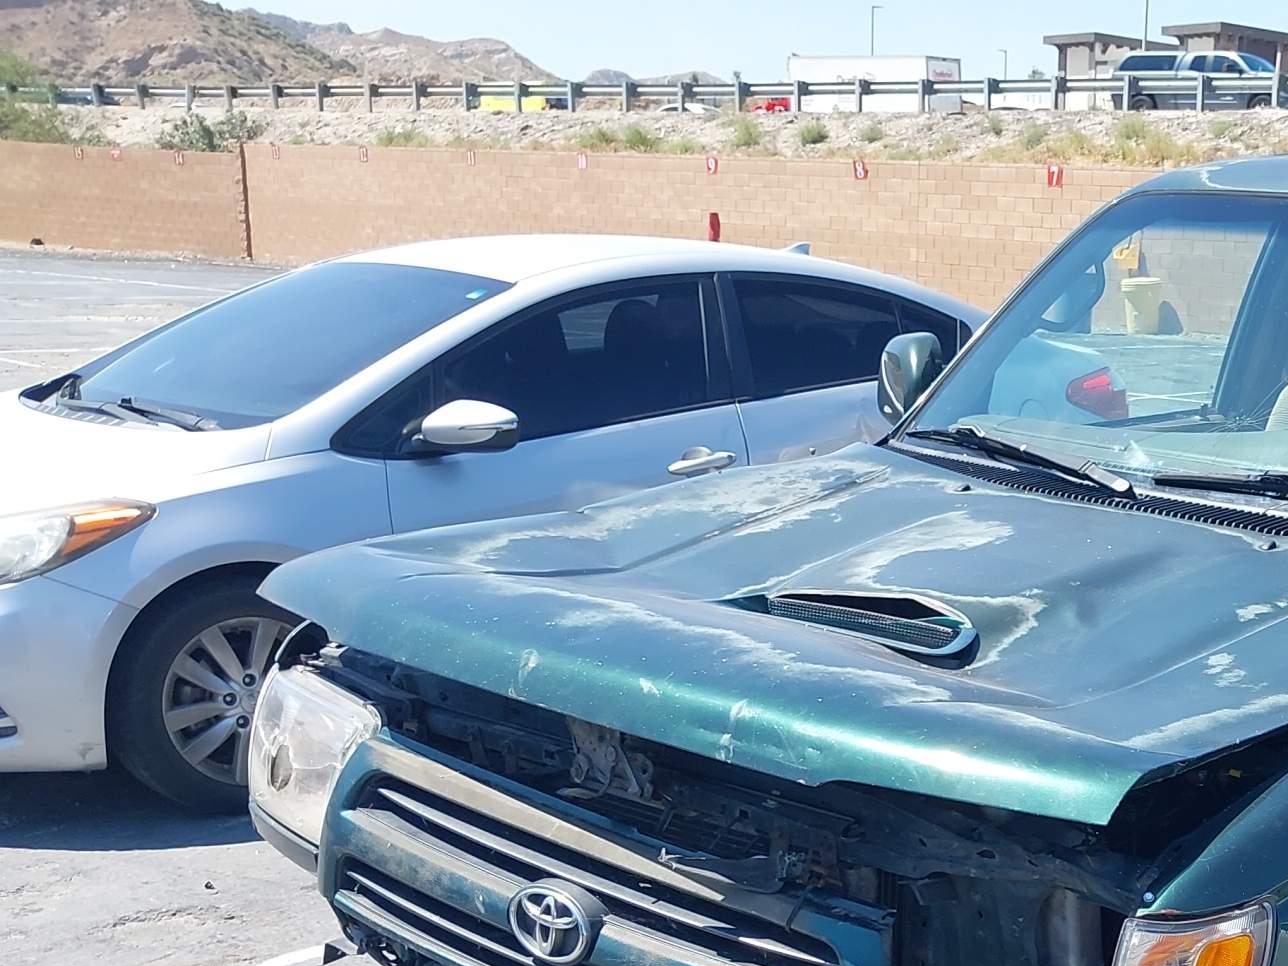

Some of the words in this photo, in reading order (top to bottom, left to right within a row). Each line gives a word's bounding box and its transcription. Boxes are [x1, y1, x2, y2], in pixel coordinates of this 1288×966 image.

[707, 156, 716, 174] 9
[855, 161, 865, 179] 8
[1049, 165, 1059, 186] 7
